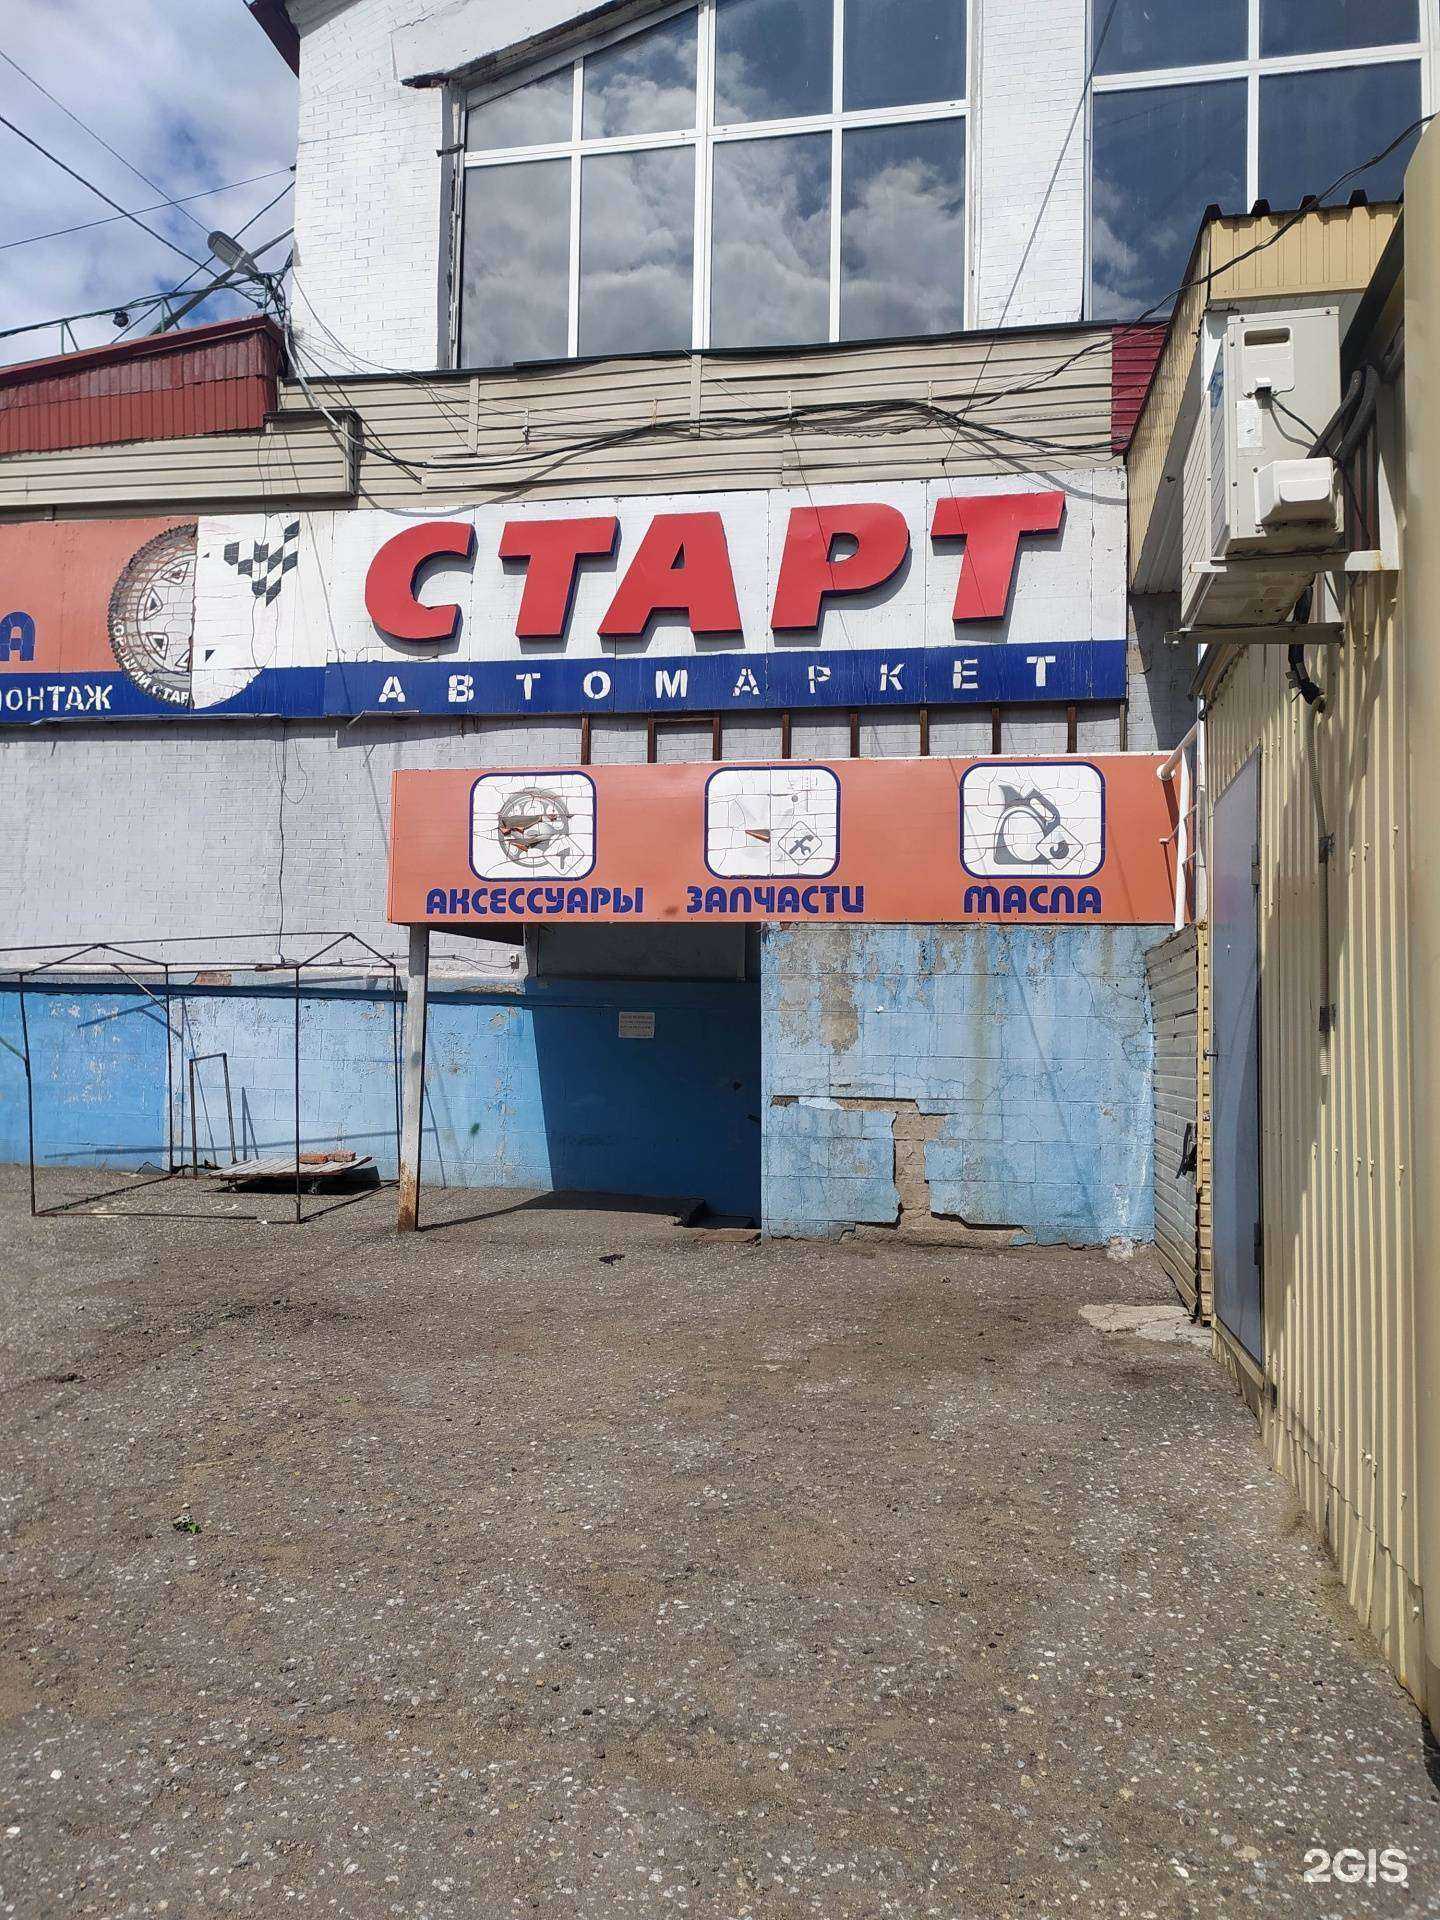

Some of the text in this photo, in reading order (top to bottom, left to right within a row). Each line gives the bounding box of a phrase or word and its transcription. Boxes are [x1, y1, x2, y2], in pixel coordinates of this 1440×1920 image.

[365, 491, 1065, 640] СТАРТ
[378, 655, 1056, 704] АВТОМАРКЕТ
[0, 684, 113, 713] ОНТАЖ
[426, 887, 643, 914] АКСЕССУАРЫ
[687, 885, 865, 914] ЗАПЧАСТИ
[964, 886, 1102, 914] МАСЛА
